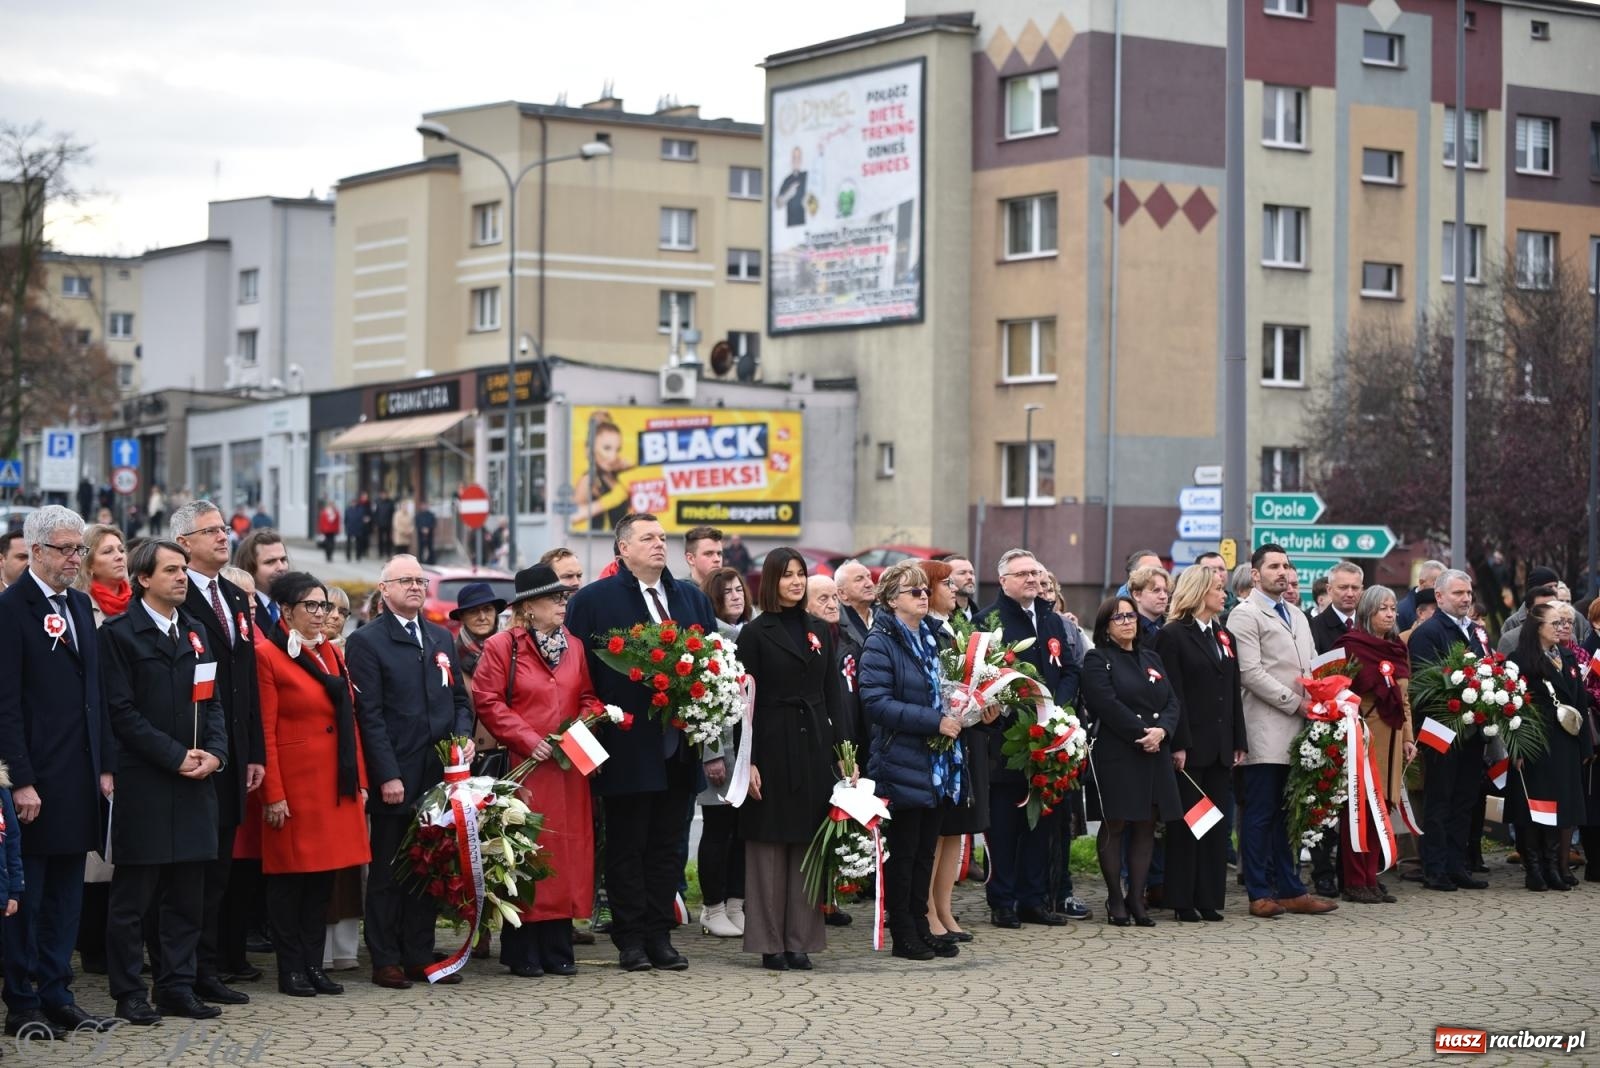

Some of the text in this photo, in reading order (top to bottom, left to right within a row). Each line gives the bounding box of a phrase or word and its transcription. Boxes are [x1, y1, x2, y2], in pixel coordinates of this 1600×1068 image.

[861, 119, 914, 141] TRENING
[861, 156, 910, 177] SUKCES
[642, 425, 764, 464] BLACK
[670, 466, 761, 490] WEEKS!
[631, 491, 667, 514] 0%
[681, 503, 777, 522] mediaexpert
[1261, 500, 1306, 519] Opole
[1260, 532, 1326, 551] Chałupki
